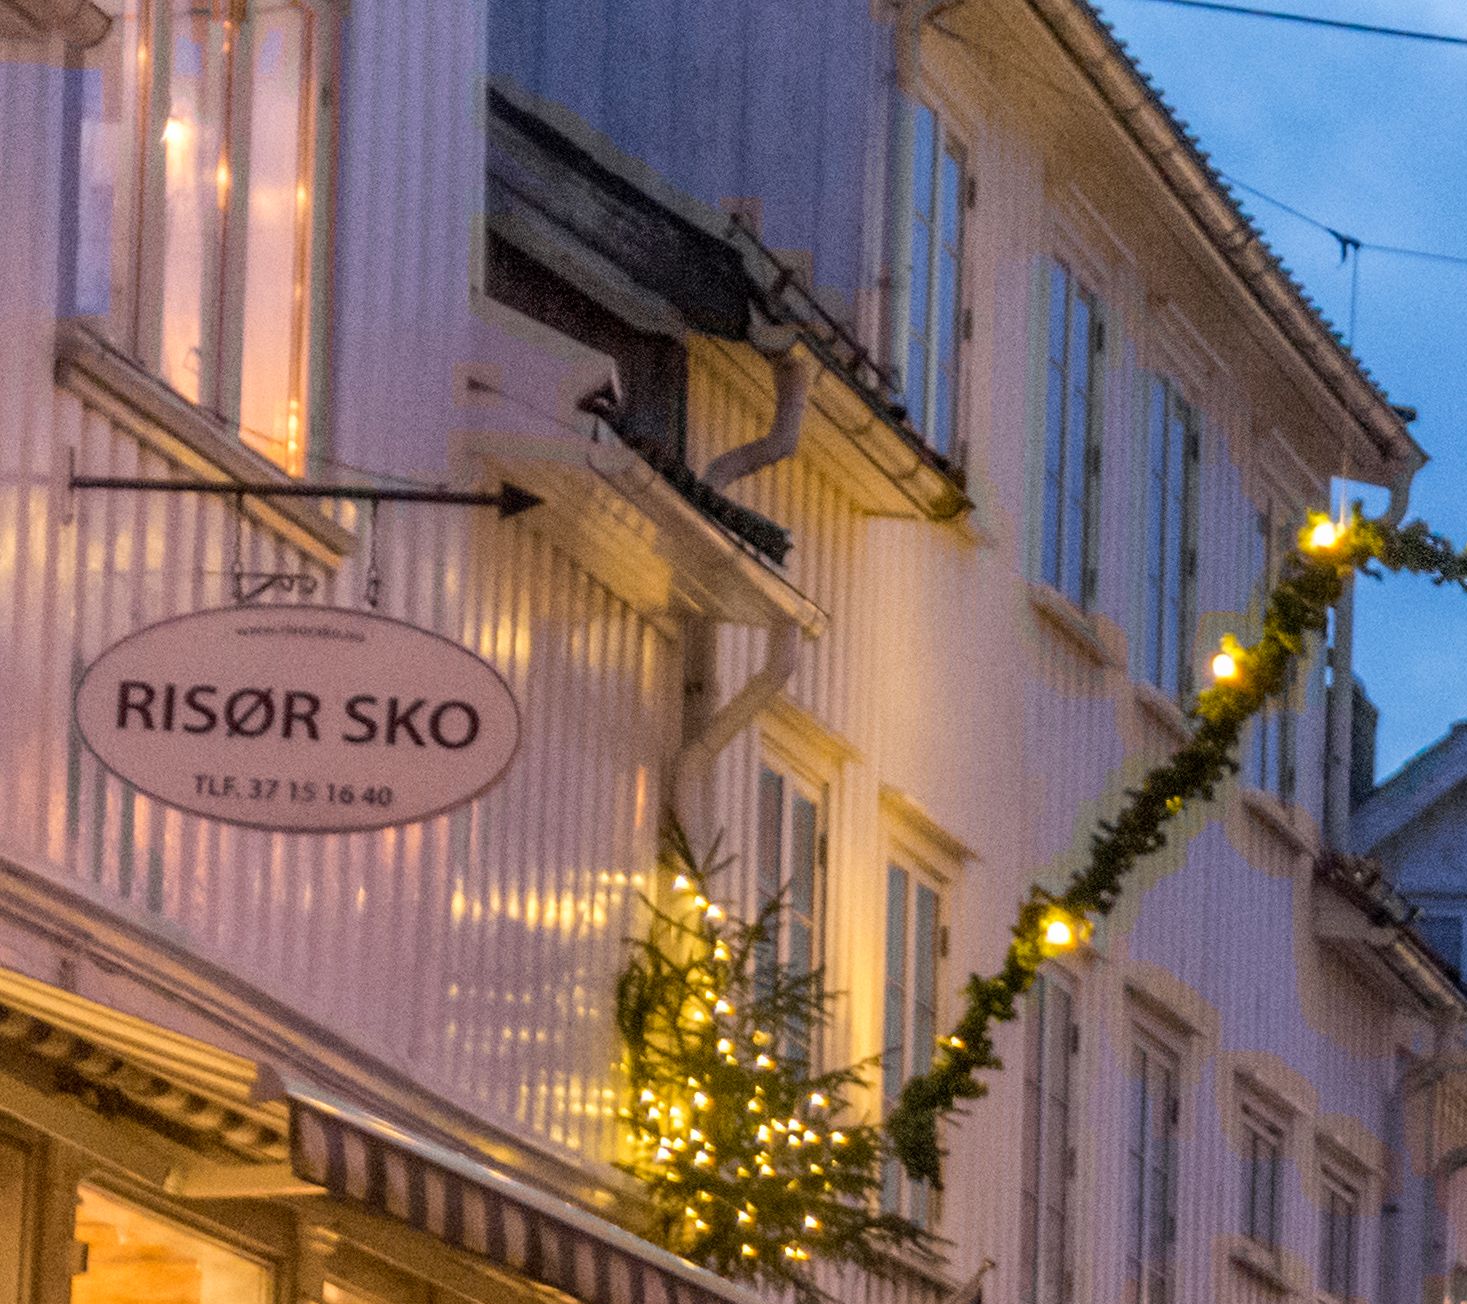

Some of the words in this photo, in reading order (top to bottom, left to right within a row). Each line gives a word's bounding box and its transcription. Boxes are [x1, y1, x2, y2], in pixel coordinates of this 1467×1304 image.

[116, 679, 320, 742] RISØR
[342, 694, 481, 750] SKO
[194, 774, 241, 799] TLF.
[249, 777, 280, 800] 37
[289, 780, 317, 803] 15
[327, 782, 355, 805] 16
[361, 785, 394, 808] 40
